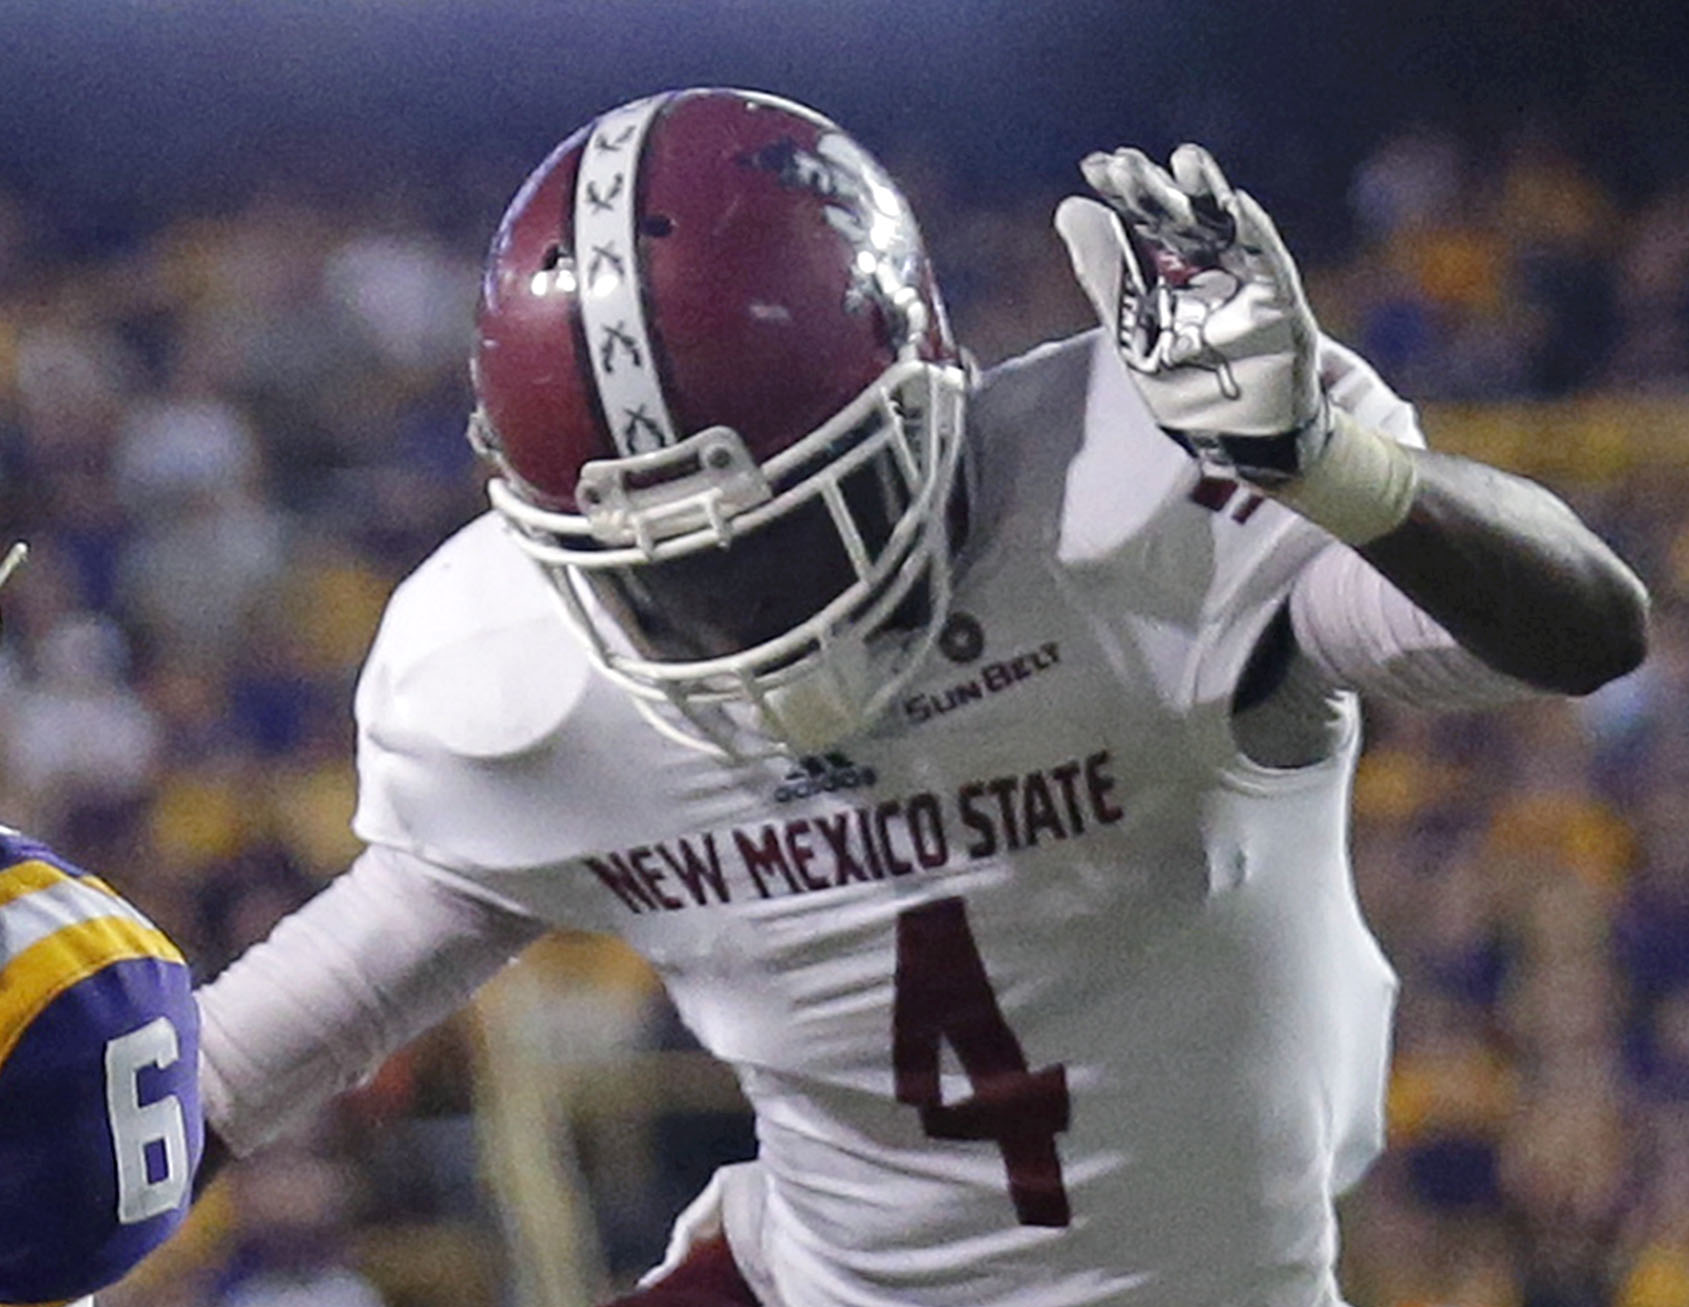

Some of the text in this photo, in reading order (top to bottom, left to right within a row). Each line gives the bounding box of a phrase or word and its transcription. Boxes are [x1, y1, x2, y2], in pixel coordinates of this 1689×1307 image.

[582, 751, 1124, 914] NEW MEXICO STATE
[105, 1016, 190, 1224] 6
[891, 895, 1072, 1228] 4
